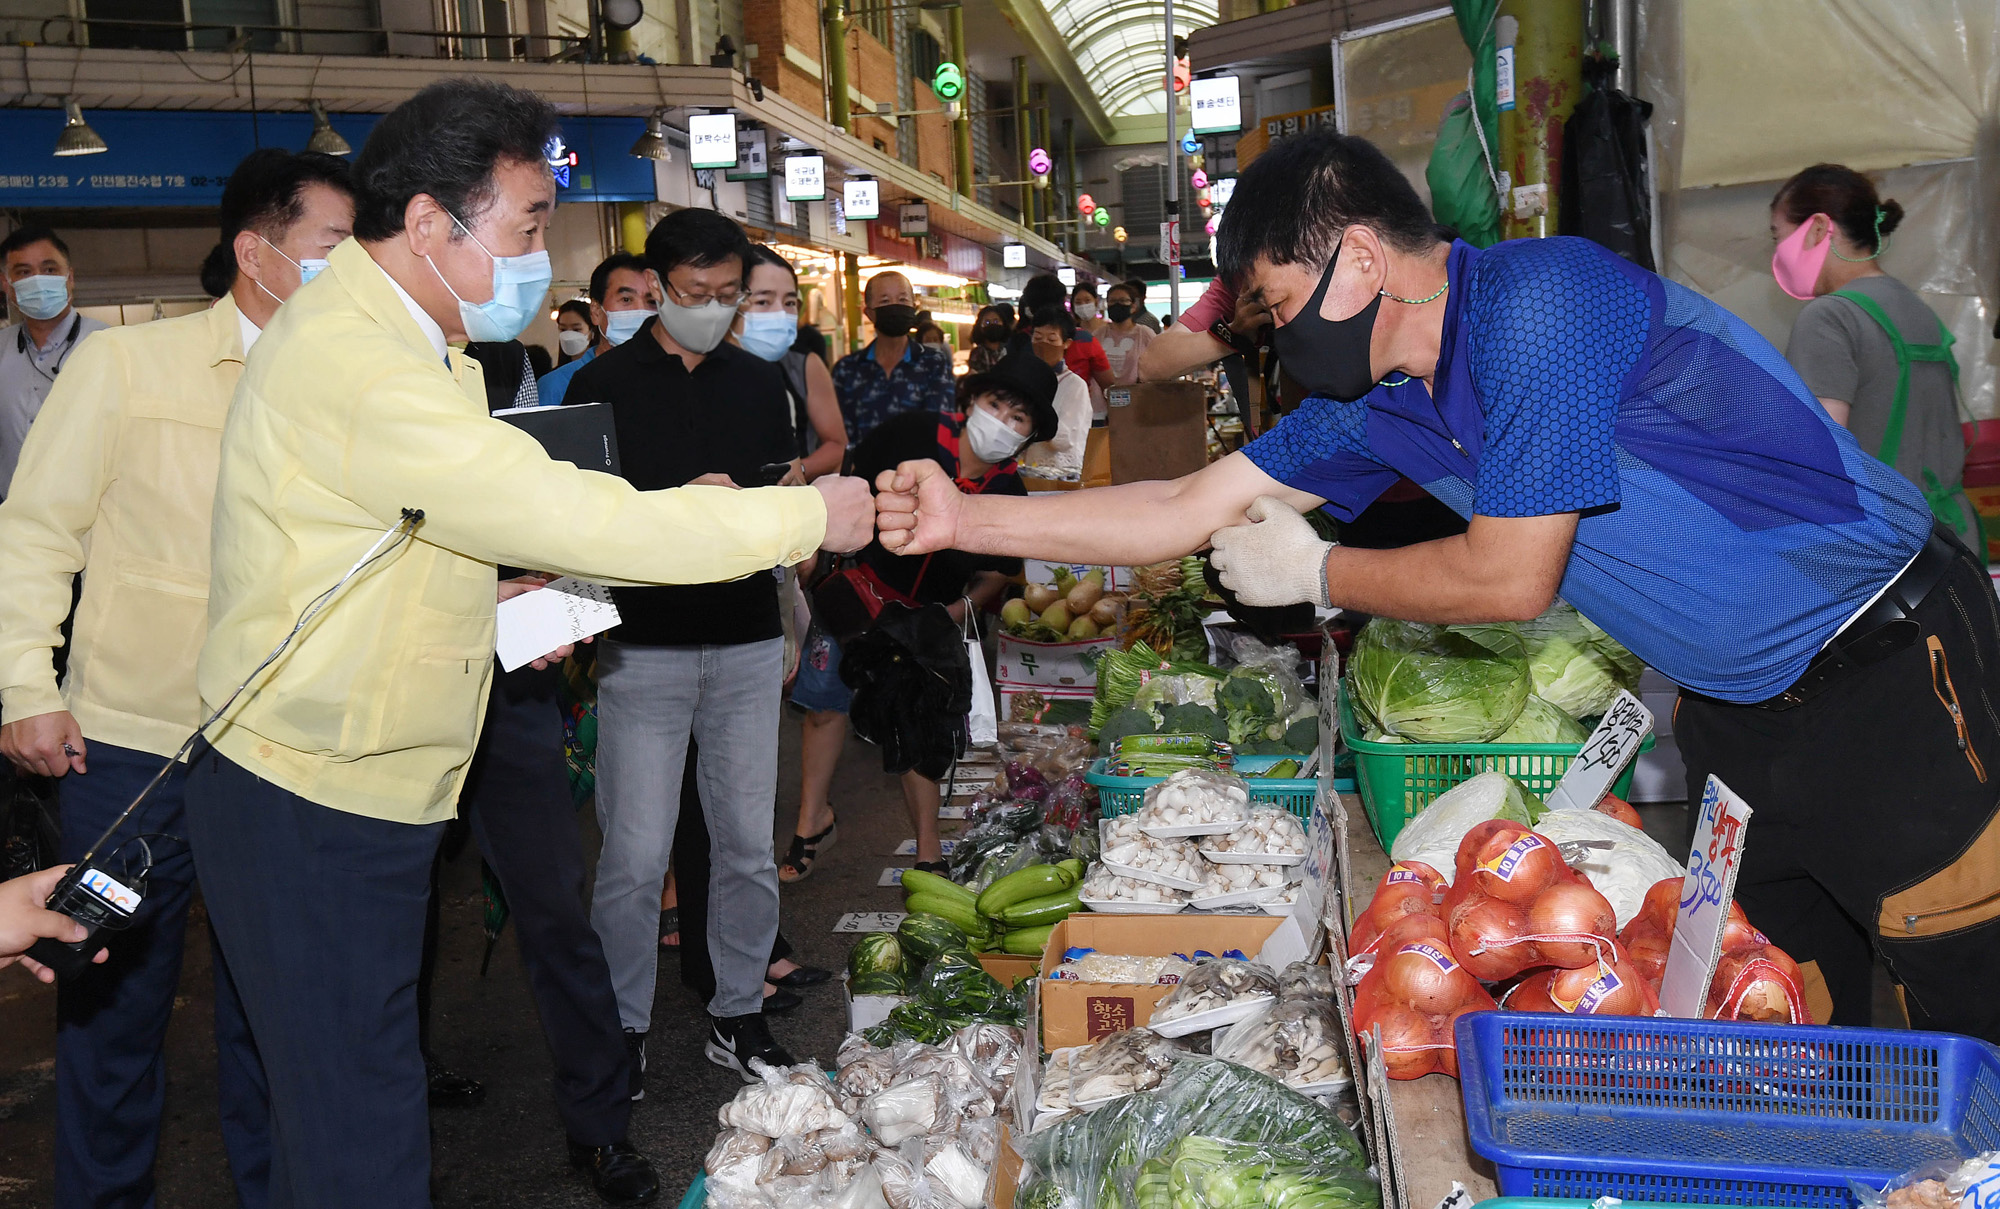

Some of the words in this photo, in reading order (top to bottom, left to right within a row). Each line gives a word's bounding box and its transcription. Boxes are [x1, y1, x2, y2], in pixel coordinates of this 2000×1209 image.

[1196, 96, 1235, 109] 배송센터
[1020, 651, 1040, 676] 무
[1092, 1000, 1127, 1019] 황소
